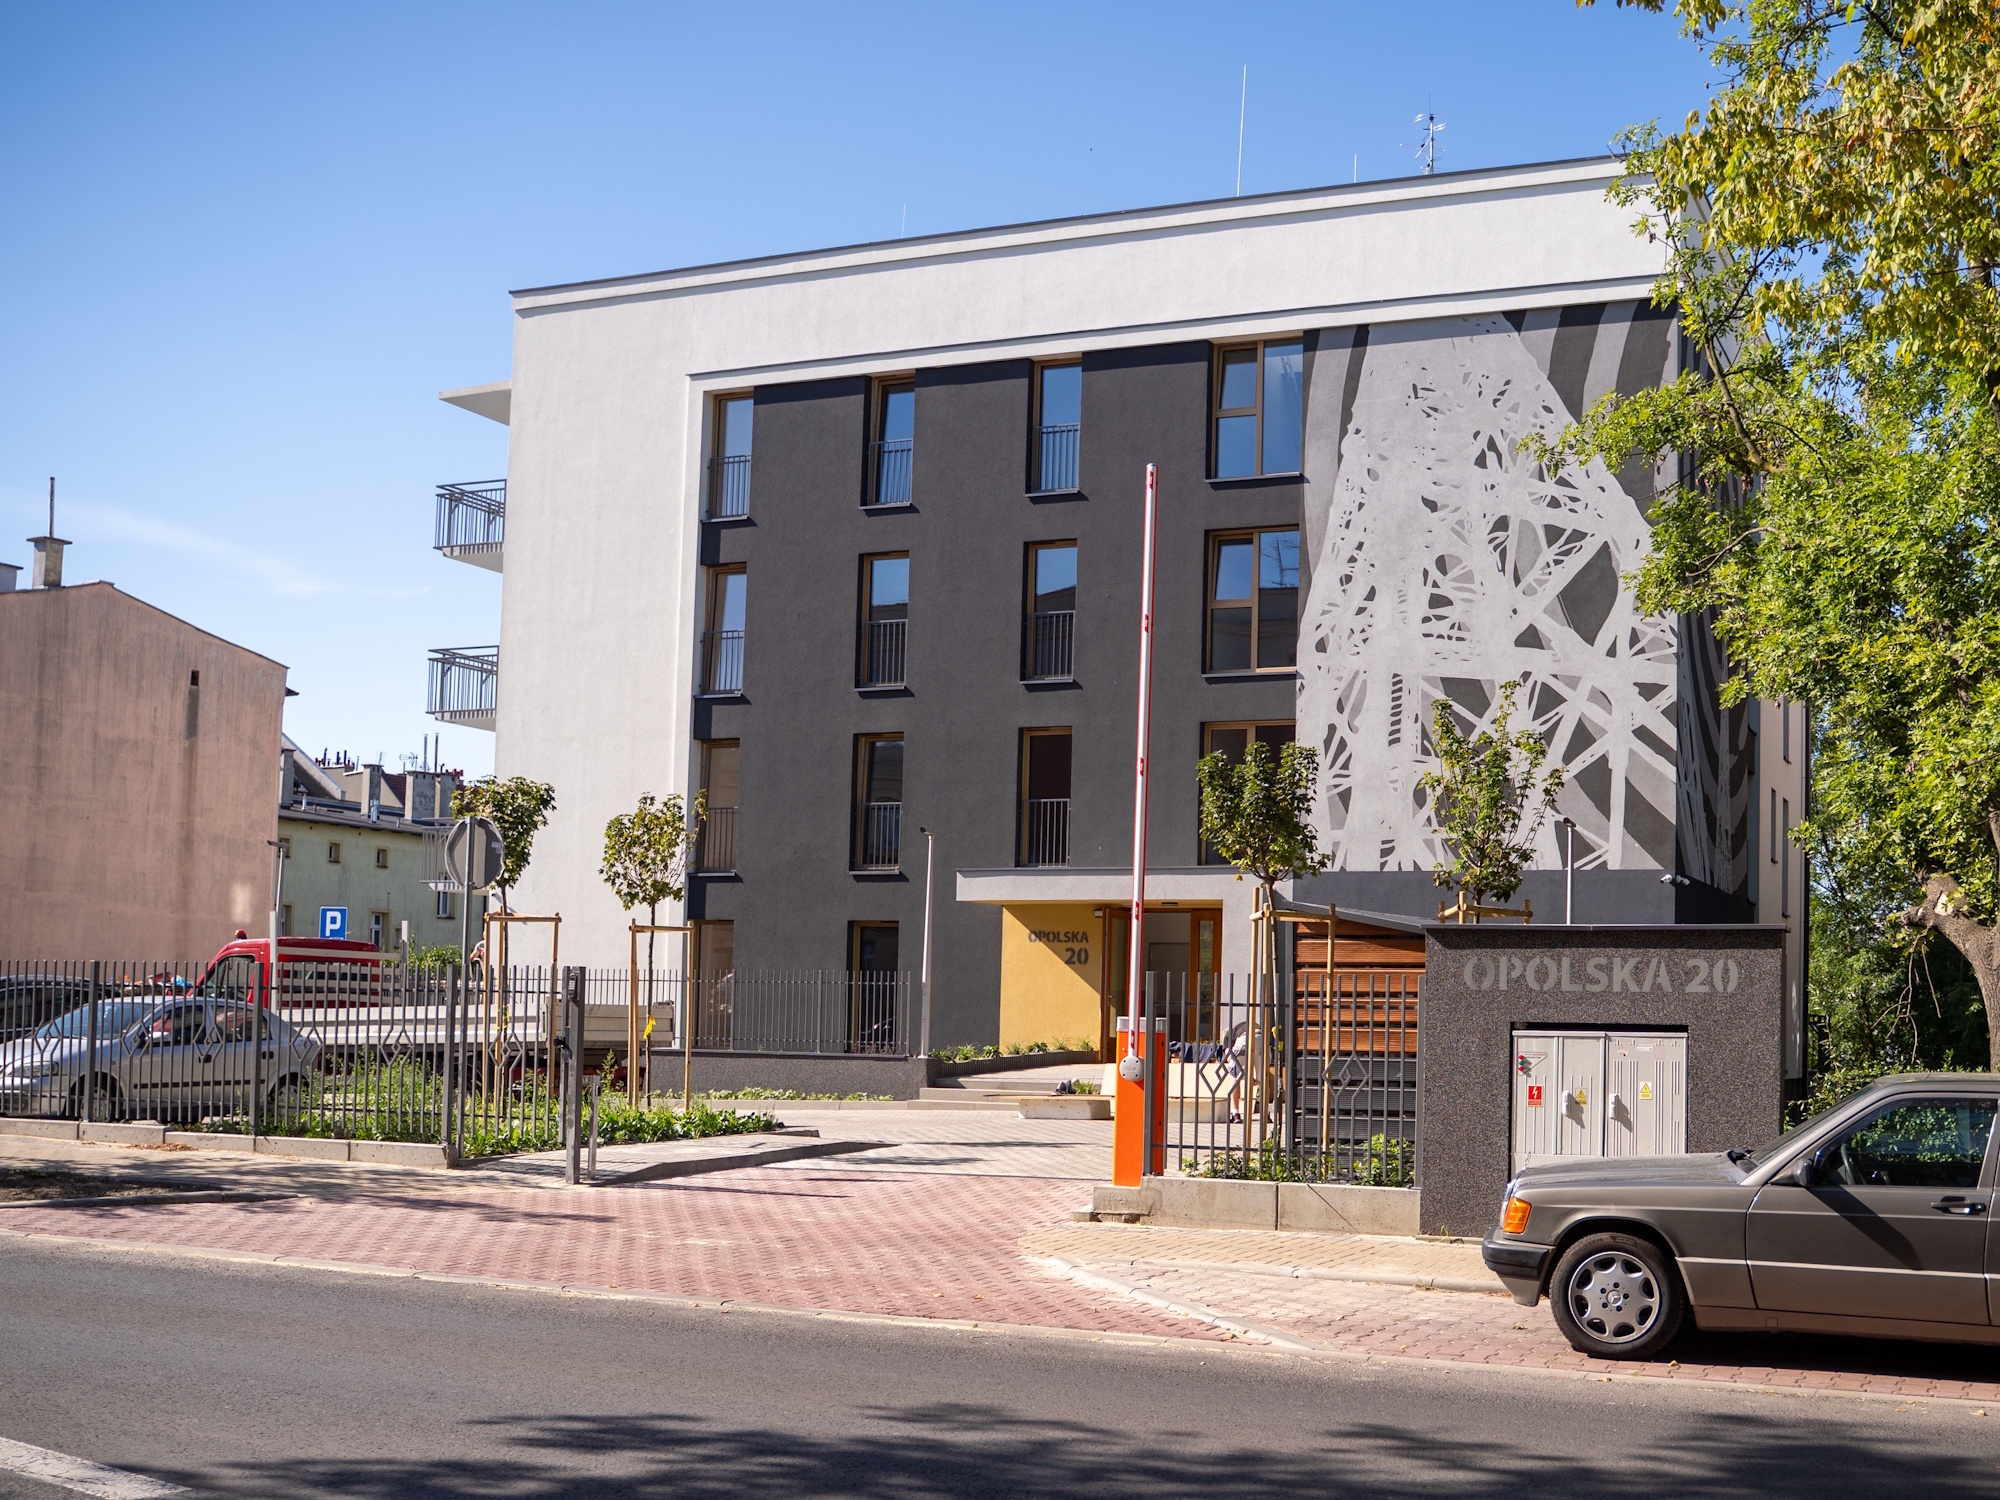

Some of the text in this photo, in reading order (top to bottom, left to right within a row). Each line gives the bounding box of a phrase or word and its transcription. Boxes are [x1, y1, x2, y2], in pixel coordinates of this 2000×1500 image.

[325, 911, 342, 937] P
[1028, 931, 1089, 944] OPOLSKA
[1065, 947, 1089, 966] 20
[1463, 955, 1739, 994] OPOLSKA 20
